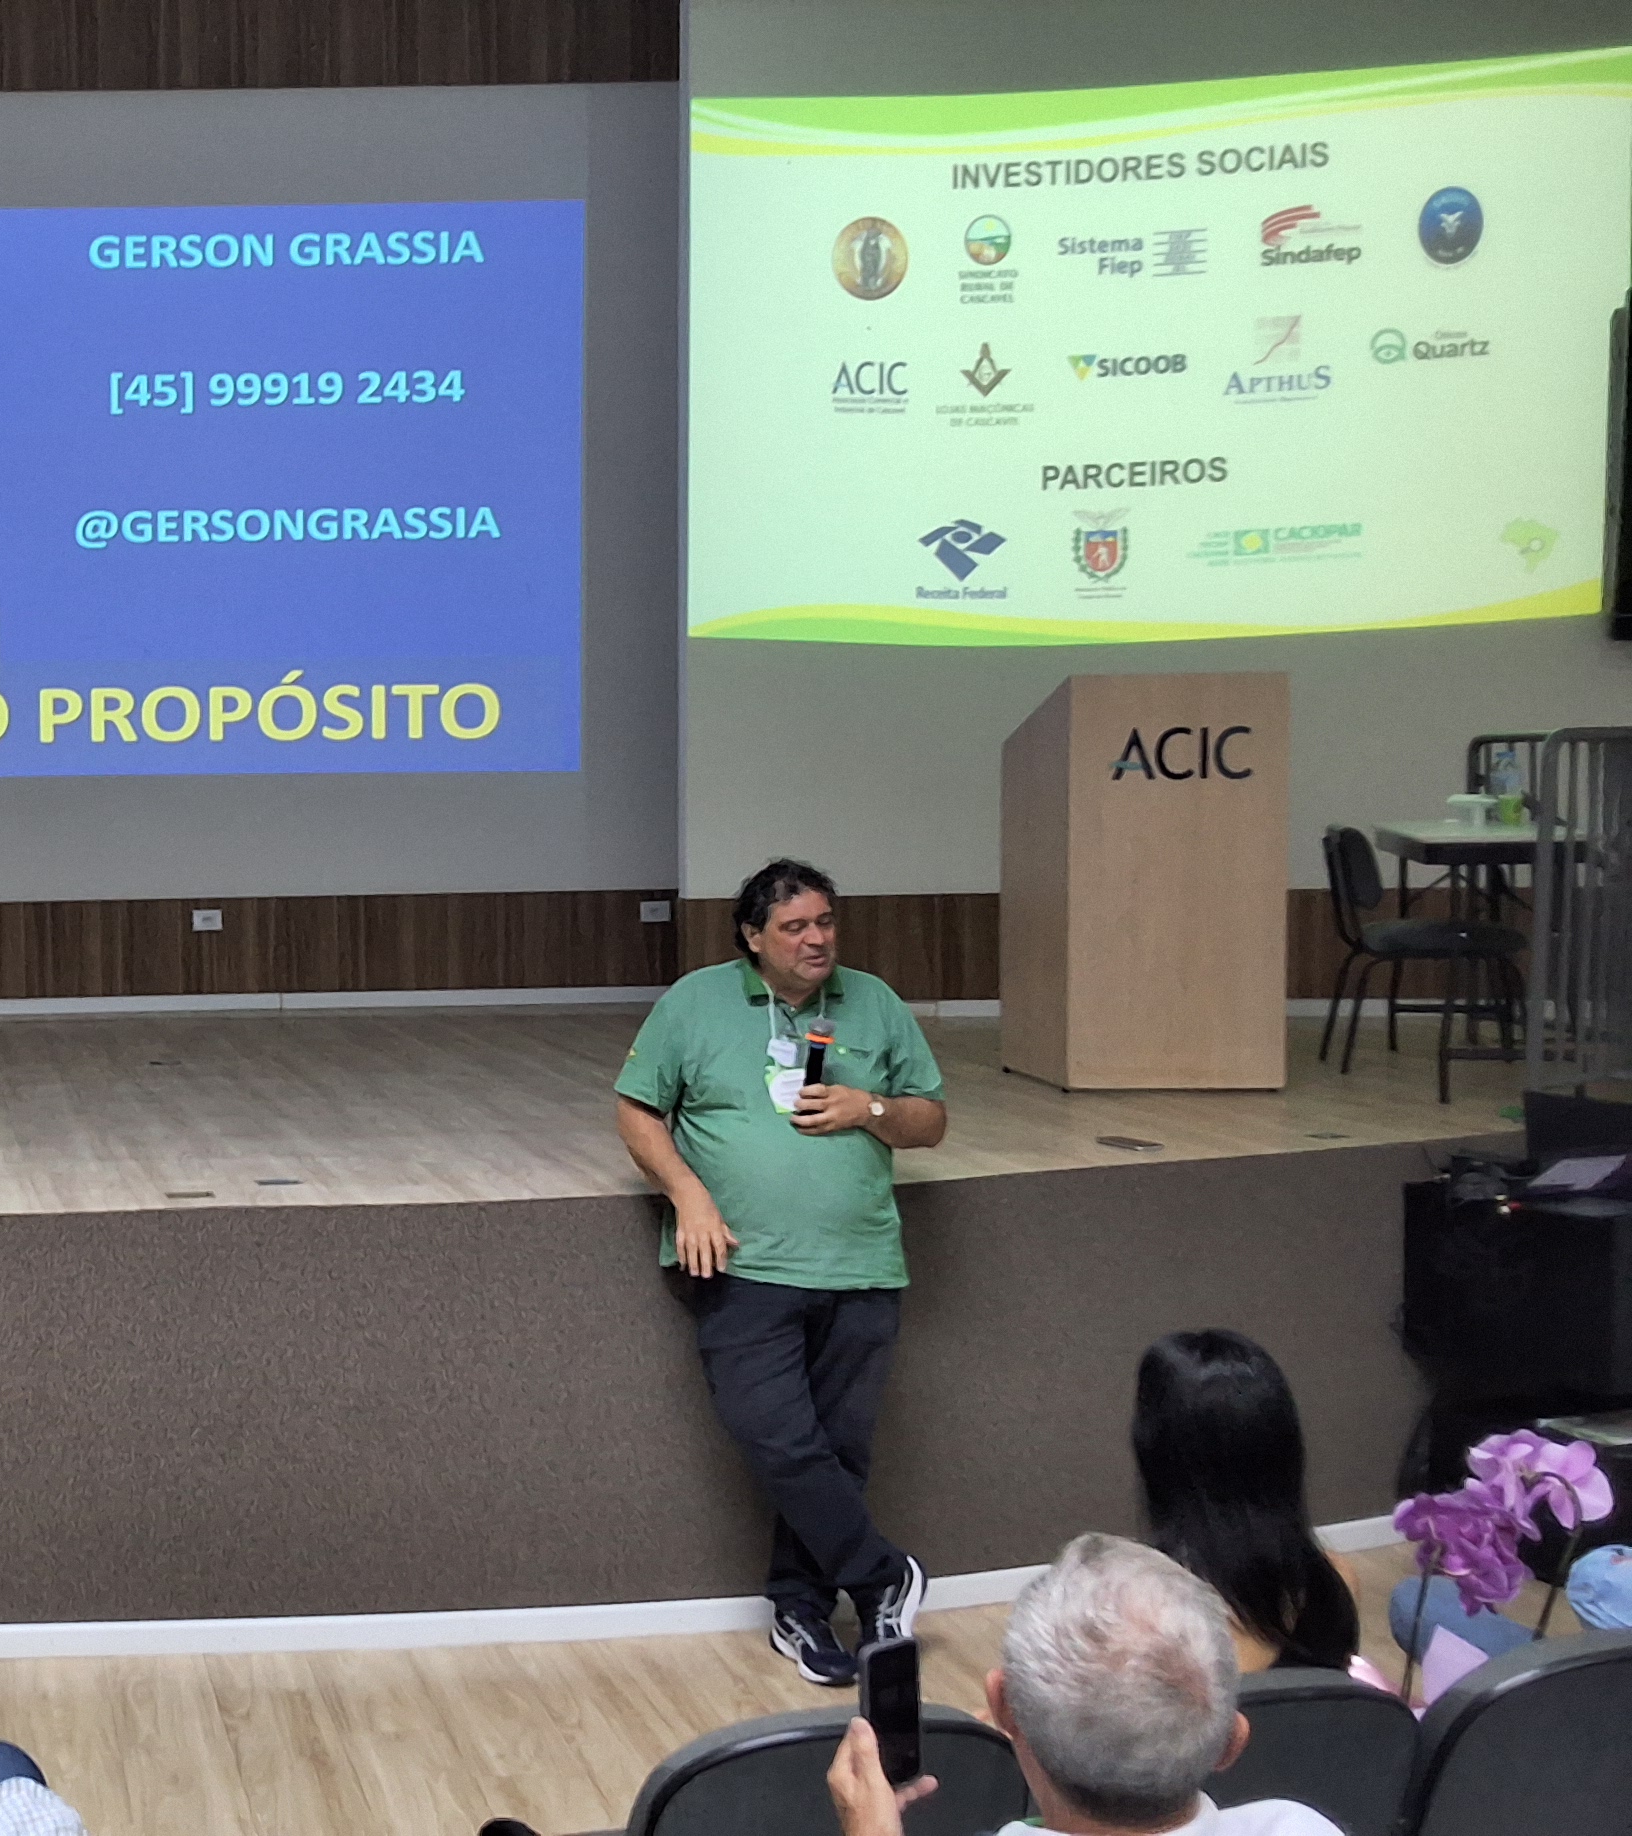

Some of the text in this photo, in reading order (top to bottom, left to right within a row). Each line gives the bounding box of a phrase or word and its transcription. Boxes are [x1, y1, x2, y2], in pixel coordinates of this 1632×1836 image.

[952, 141, 1330, 190] INVESTIDORES SOCIAIS
[88, 230, 485, 269] GERSON GRASSIA
[1057, 235, 1144, 257] Sistema
[1260, 244, 1362, 267] Sindafep
[1097, 257, 1143, 278] Fiep
[1096, 353, 1187, 377] SICOOB
[1412, 338, 1490, 360] Quartz
[109, 369, 466, 415] [45] 99919 2434
[831, 361, 909, 396] ACIC
[1040, 456, 1229, 491] PARCEIROS
[74, 506, 502, 549] @GERSONGRASSIA
[38, 669, 501, 744] PROPÓSITO
[1110, 725, 1254, 781] ACIC
